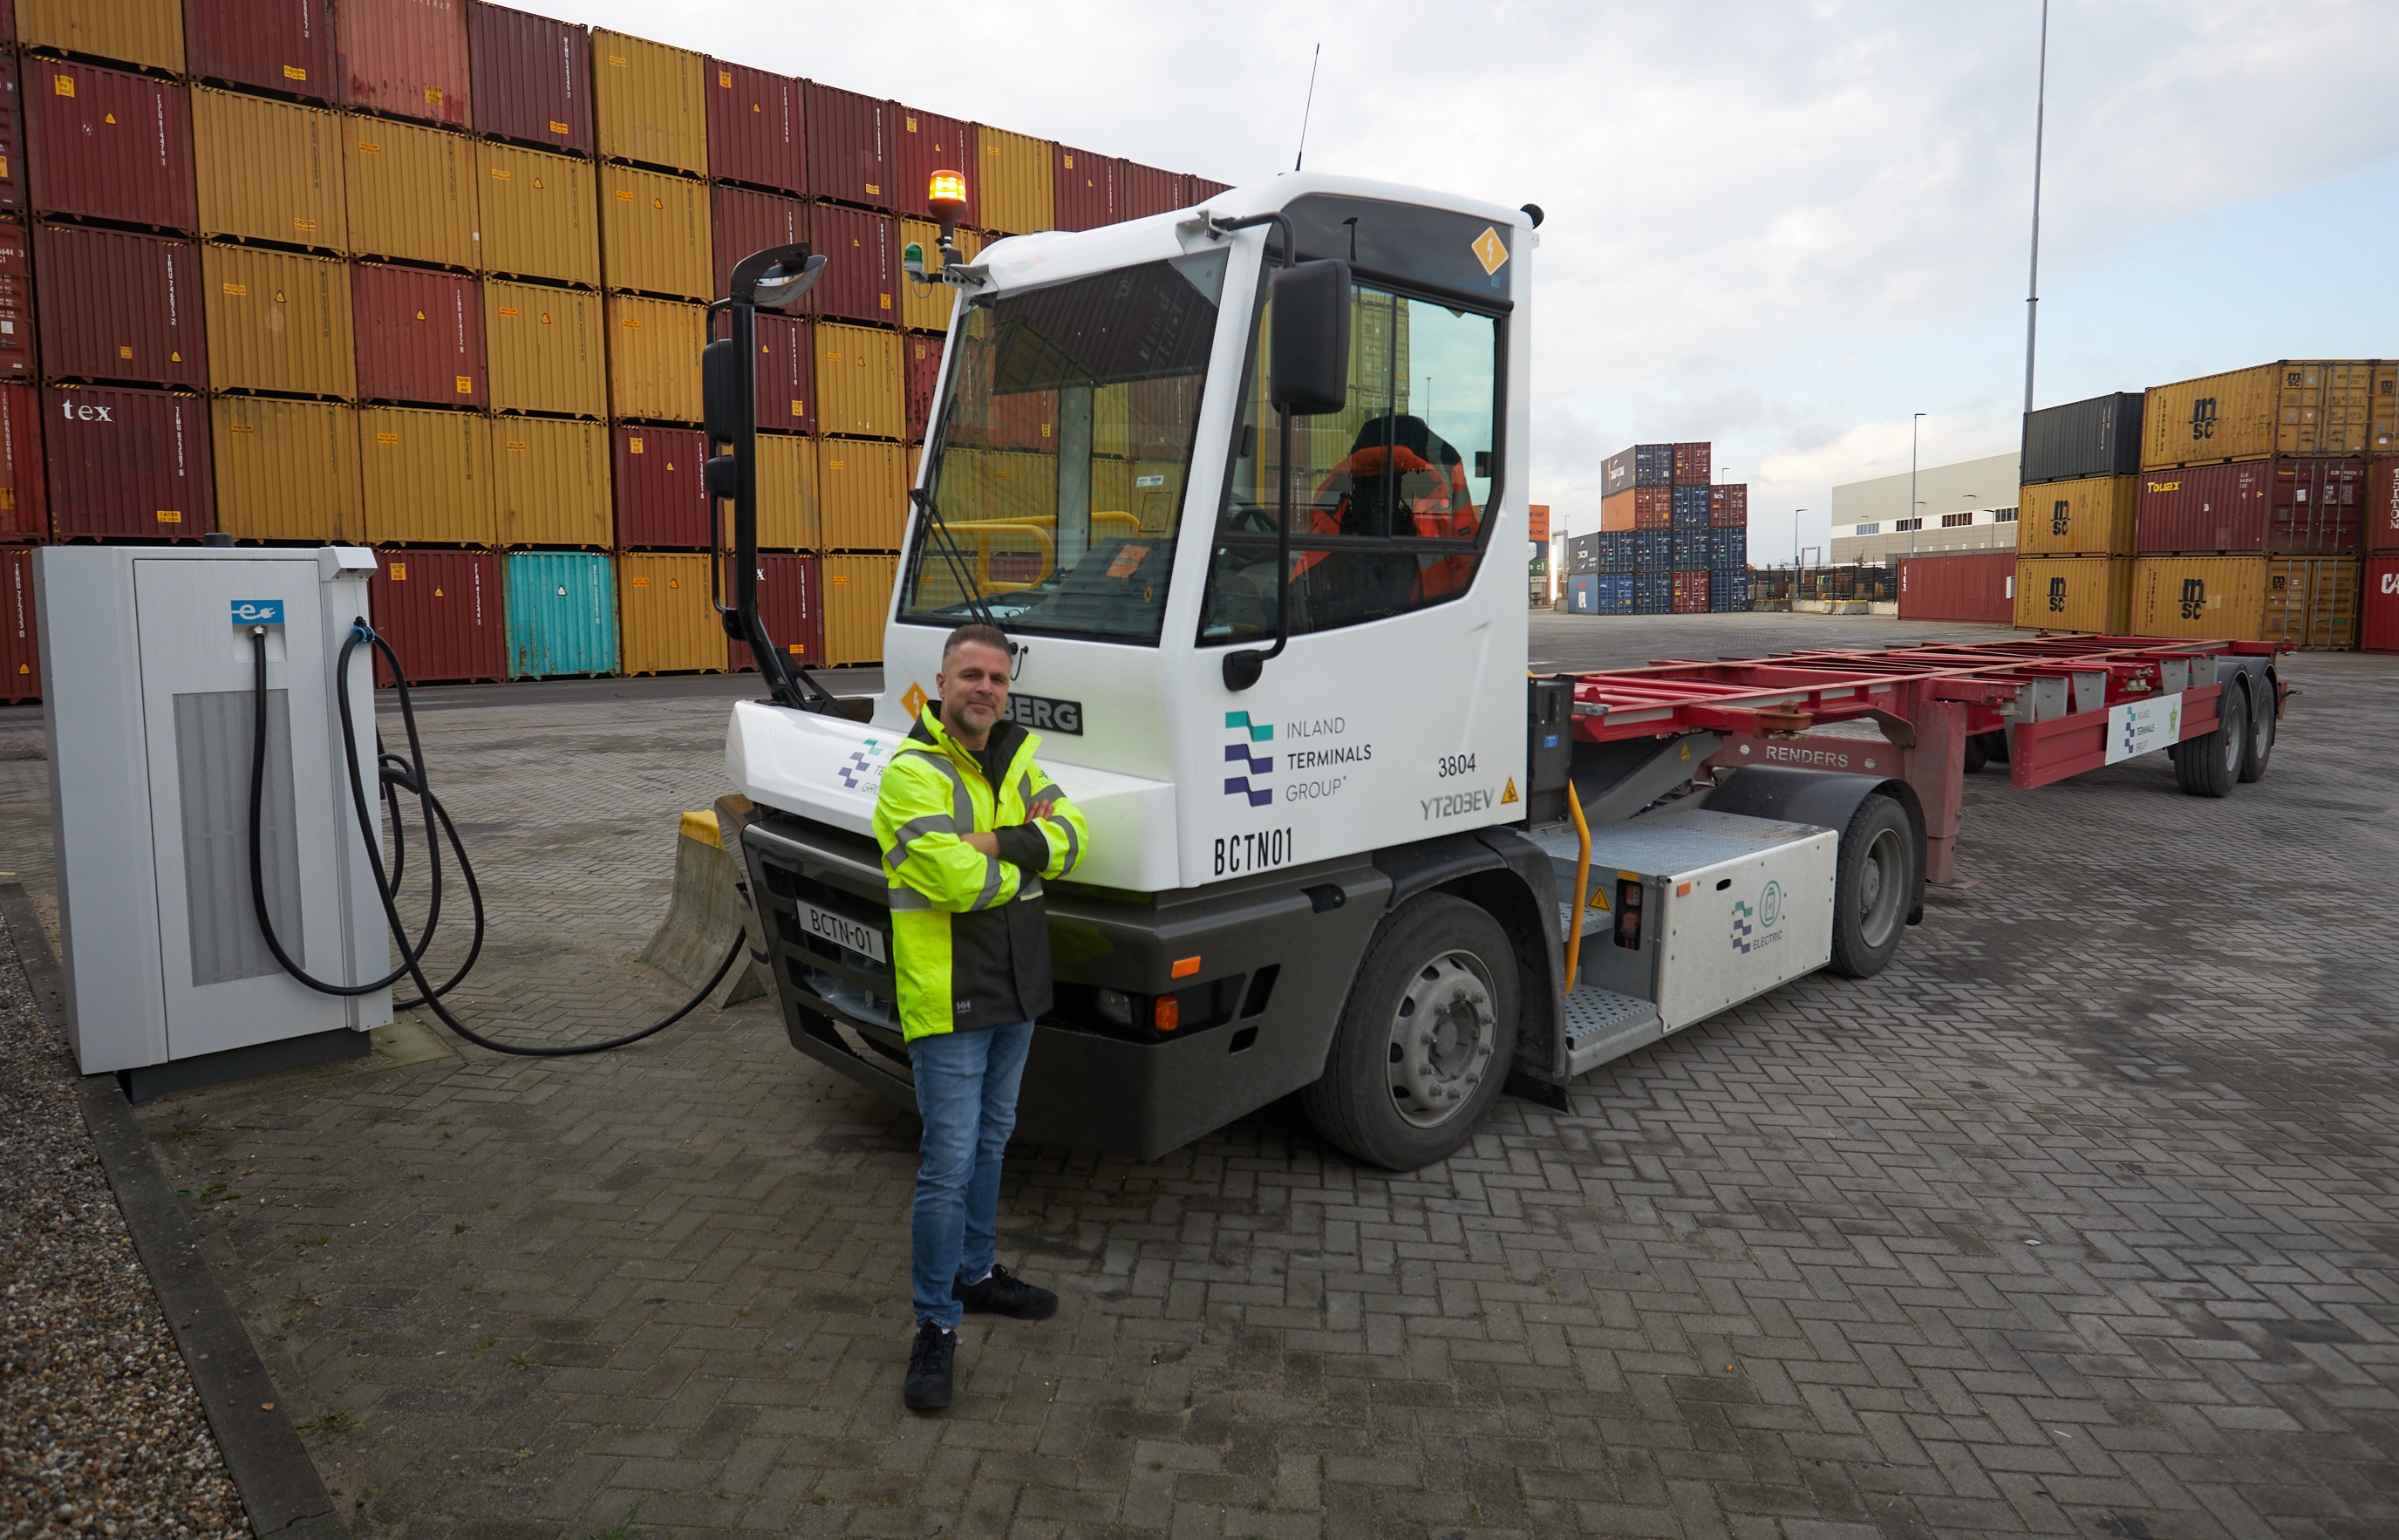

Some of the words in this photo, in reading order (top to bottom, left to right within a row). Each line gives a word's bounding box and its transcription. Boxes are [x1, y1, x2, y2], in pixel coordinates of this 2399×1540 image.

[61, 399, 113, 421] tex
[2147, 481, 2180, 493] Touax
[1287, 717, 1346, 739] INLAND
[1287, 744, 1373, 771] TERMINALS
[1438, 753, 1477, 779] 3804
[1766, 745, 1849, 768] RENDERS
[1421, 787, 1496, 821] YT203EV
[1215, 827, 1292, 877] BCTN01
[809, 908, 874, 955] BCTN-01
[1753, 930, 1783, 951] ELECTRIC
[956, 1000, 971, 1011] HH
